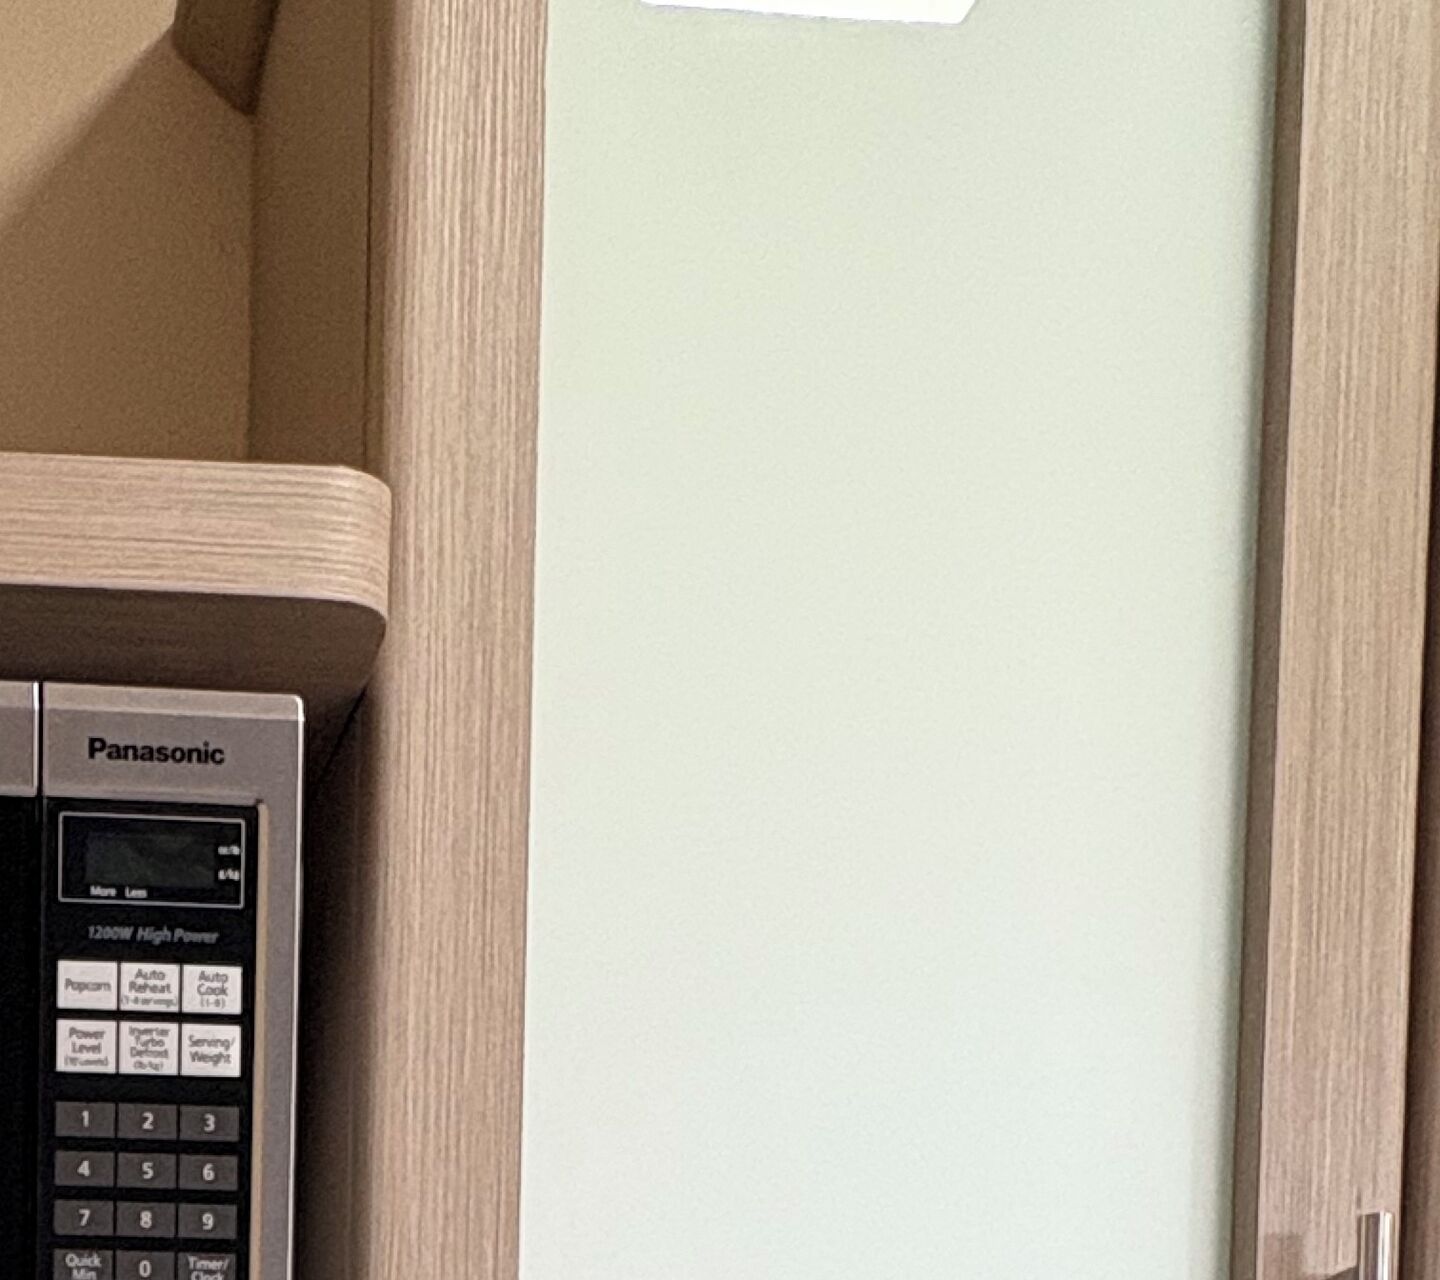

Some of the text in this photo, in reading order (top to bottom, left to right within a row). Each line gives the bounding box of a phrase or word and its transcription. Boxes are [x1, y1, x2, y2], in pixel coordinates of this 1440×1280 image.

[87, 736, 226, 765] Panasonic
[88, 925, 220, 945] 1200W High Power
[134, 968, 166, 981] Auto
[199, 970, 228, 983] Auto
[64, 977, 112, 995] Popcorn
[128, 981, 173, 994] Reheat
[197, 983, 229, 997] Cook
[69, 1027, 106, 1040] Power
[189, 1051, 232, 1067] Weight
[81, 1110, 90, 1128] 1
[142, 1112, 154, 1130] 2
[203, 1113, 216, 1132] 3
[77, 1160, 90, 1177] 4
[141, 1162, 154, 1179] 5
[202, 1163, 215, 1181] 6
[78, 1208, 91, 1226] 7
[139, 1210, 153, 1229] 8
[202, 1212, 215, 1231] 9
[65, 1252, 102, 1268] Quick
[138, 1260, 152, 1278] 0
[72, 1268, 97, 1280] Min
